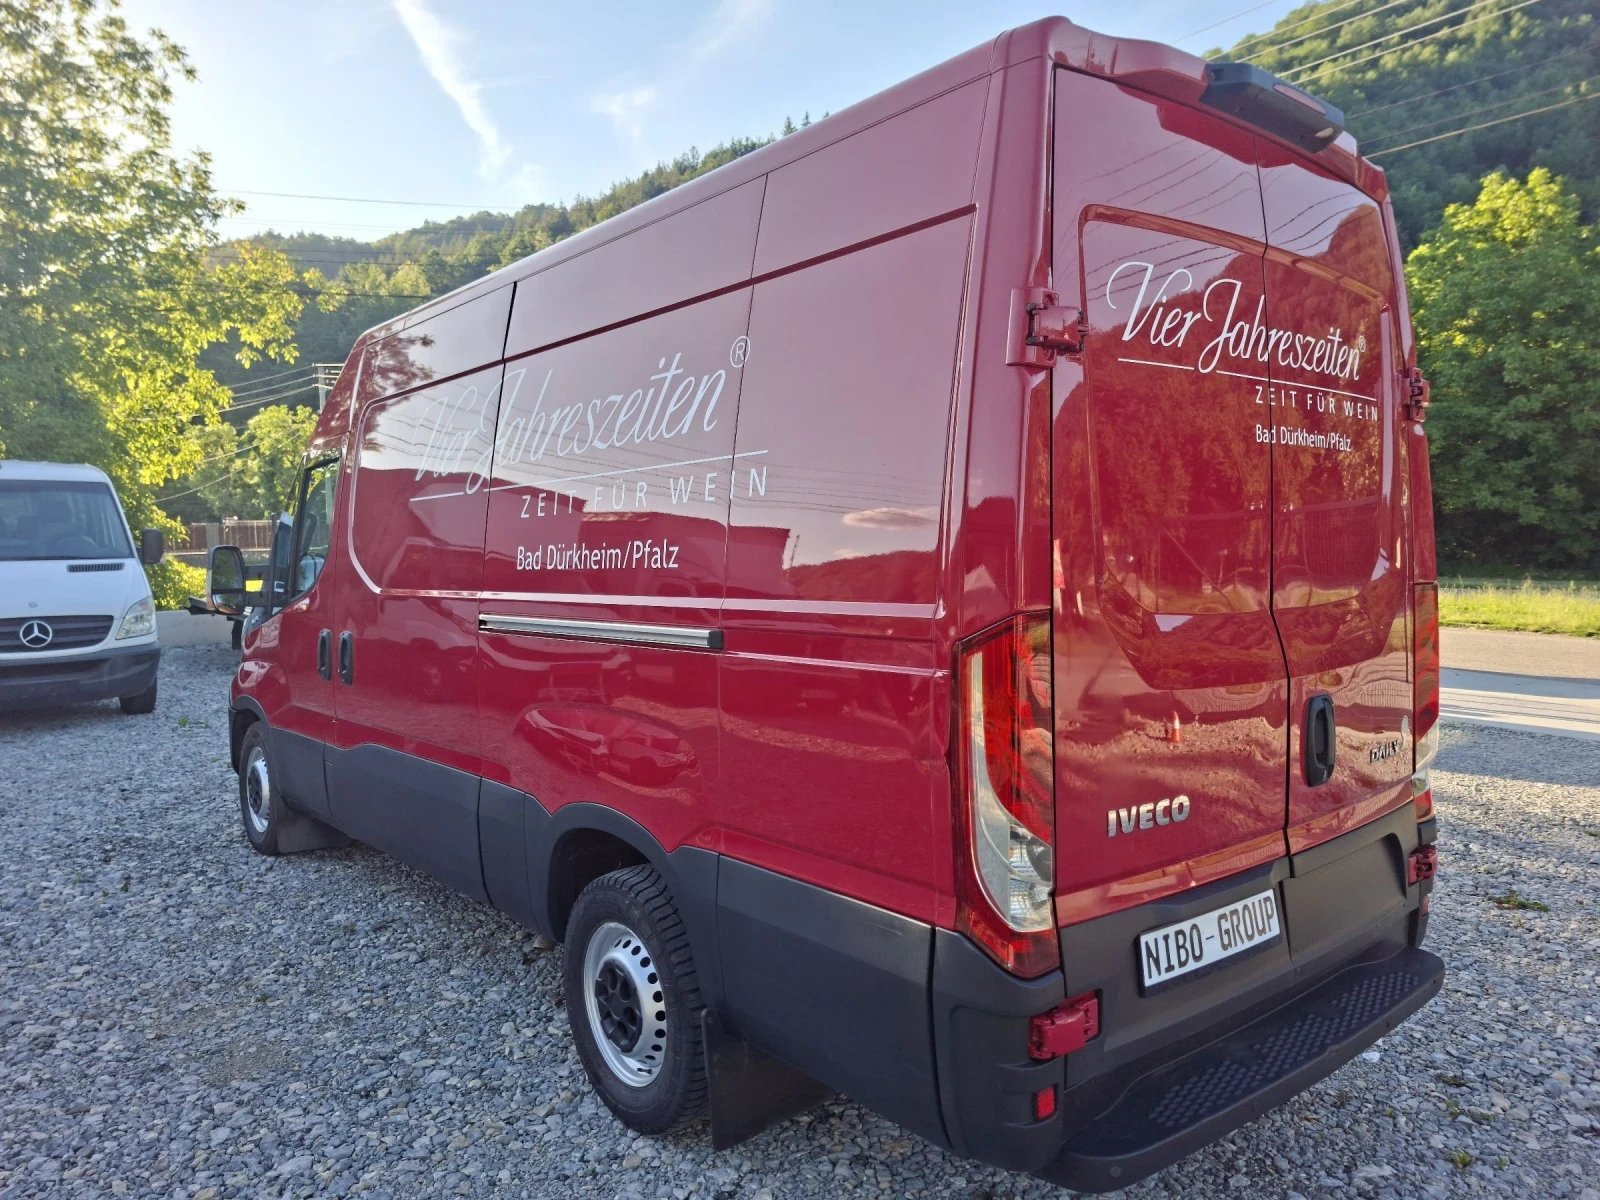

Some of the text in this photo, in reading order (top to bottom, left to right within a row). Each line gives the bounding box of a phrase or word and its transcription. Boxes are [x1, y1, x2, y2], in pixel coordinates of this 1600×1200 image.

[1106, 261, 1202, 348] Vier
[1255, 385, 1379, 421] ZEIT FÜR WEIN
[413, 386, 480, 482] Vier
[1255, 423, 1277, 444] Bad
[521, 465, 768, 518] ZEIT FÜR WEIN
[516, 545, 543, 570] Bad
[1369, 739, 1402, 763] DAILY
[1107, 795, 1191, 838] IVECO
